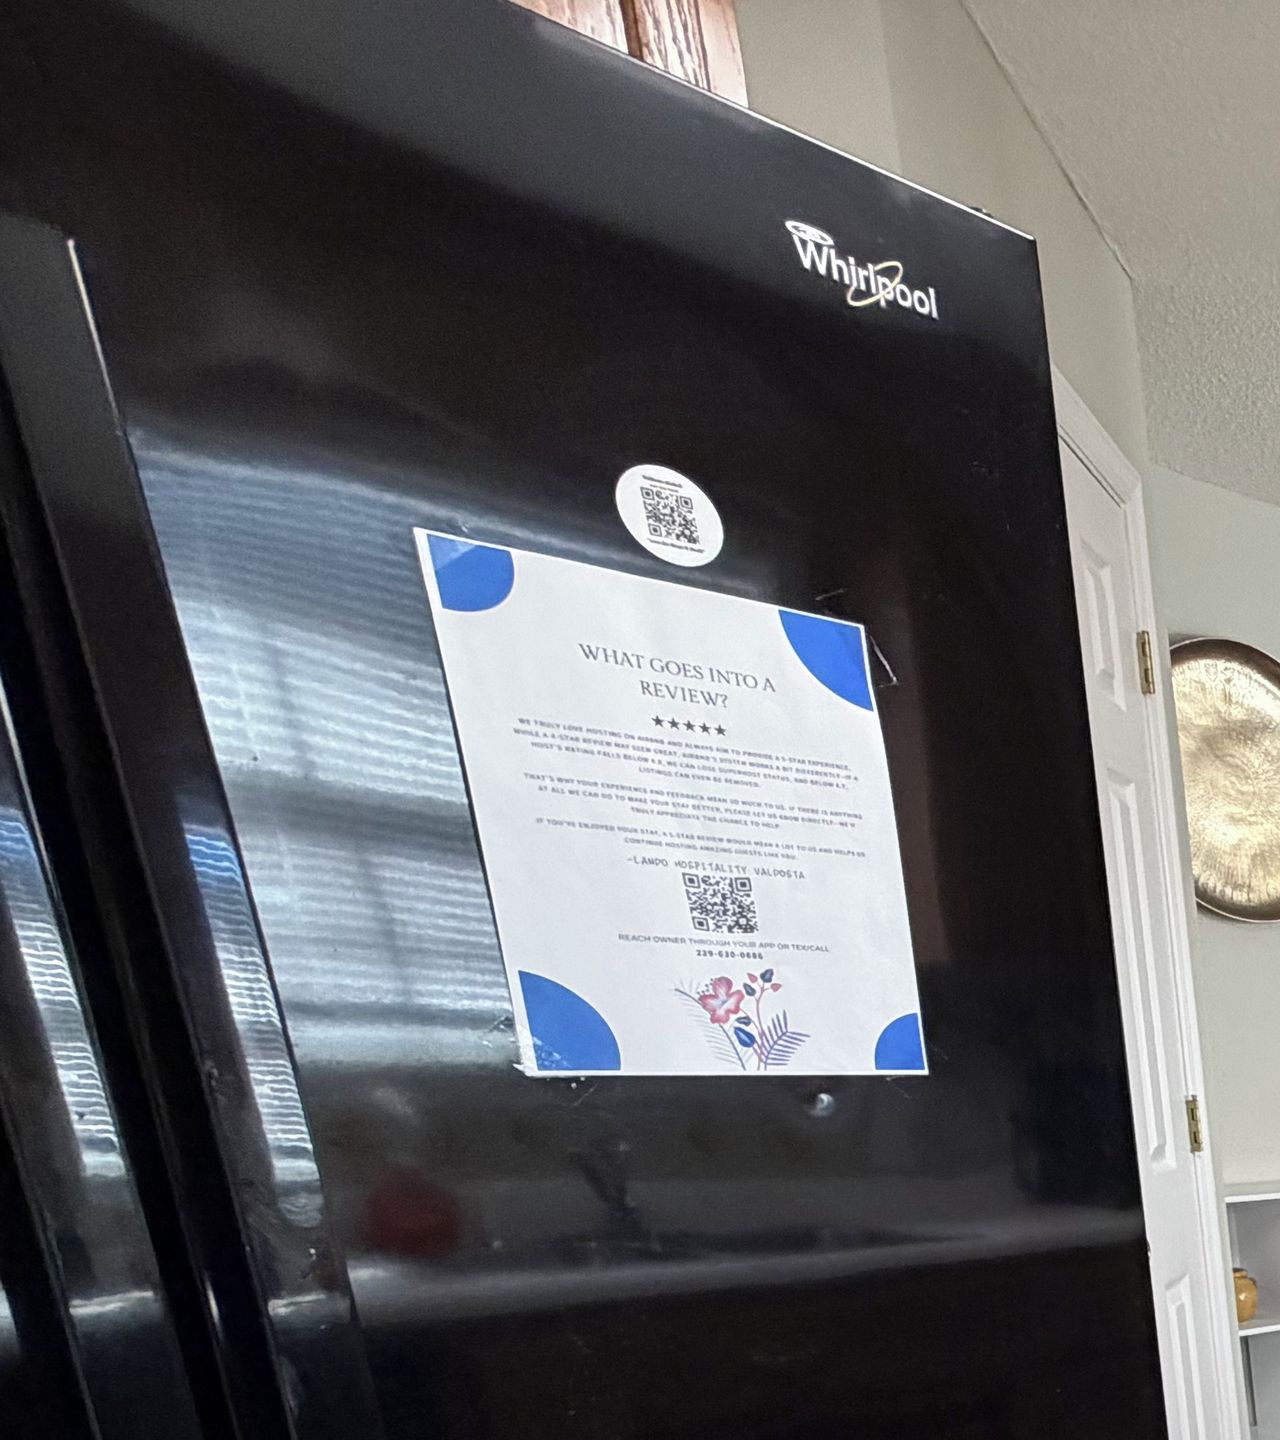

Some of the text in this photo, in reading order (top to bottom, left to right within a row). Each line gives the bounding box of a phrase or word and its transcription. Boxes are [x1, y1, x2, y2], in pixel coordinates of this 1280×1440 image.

[793, 233, 939, 320] Whirlpool
[578, 642, 776, 693] WHAT GOES INTO A
[640, 680, 729, 708] REVIEW?
[674, 860, 748, 874] HOSPITALITY
[753, 866, 805, 880] VALDOSTA
